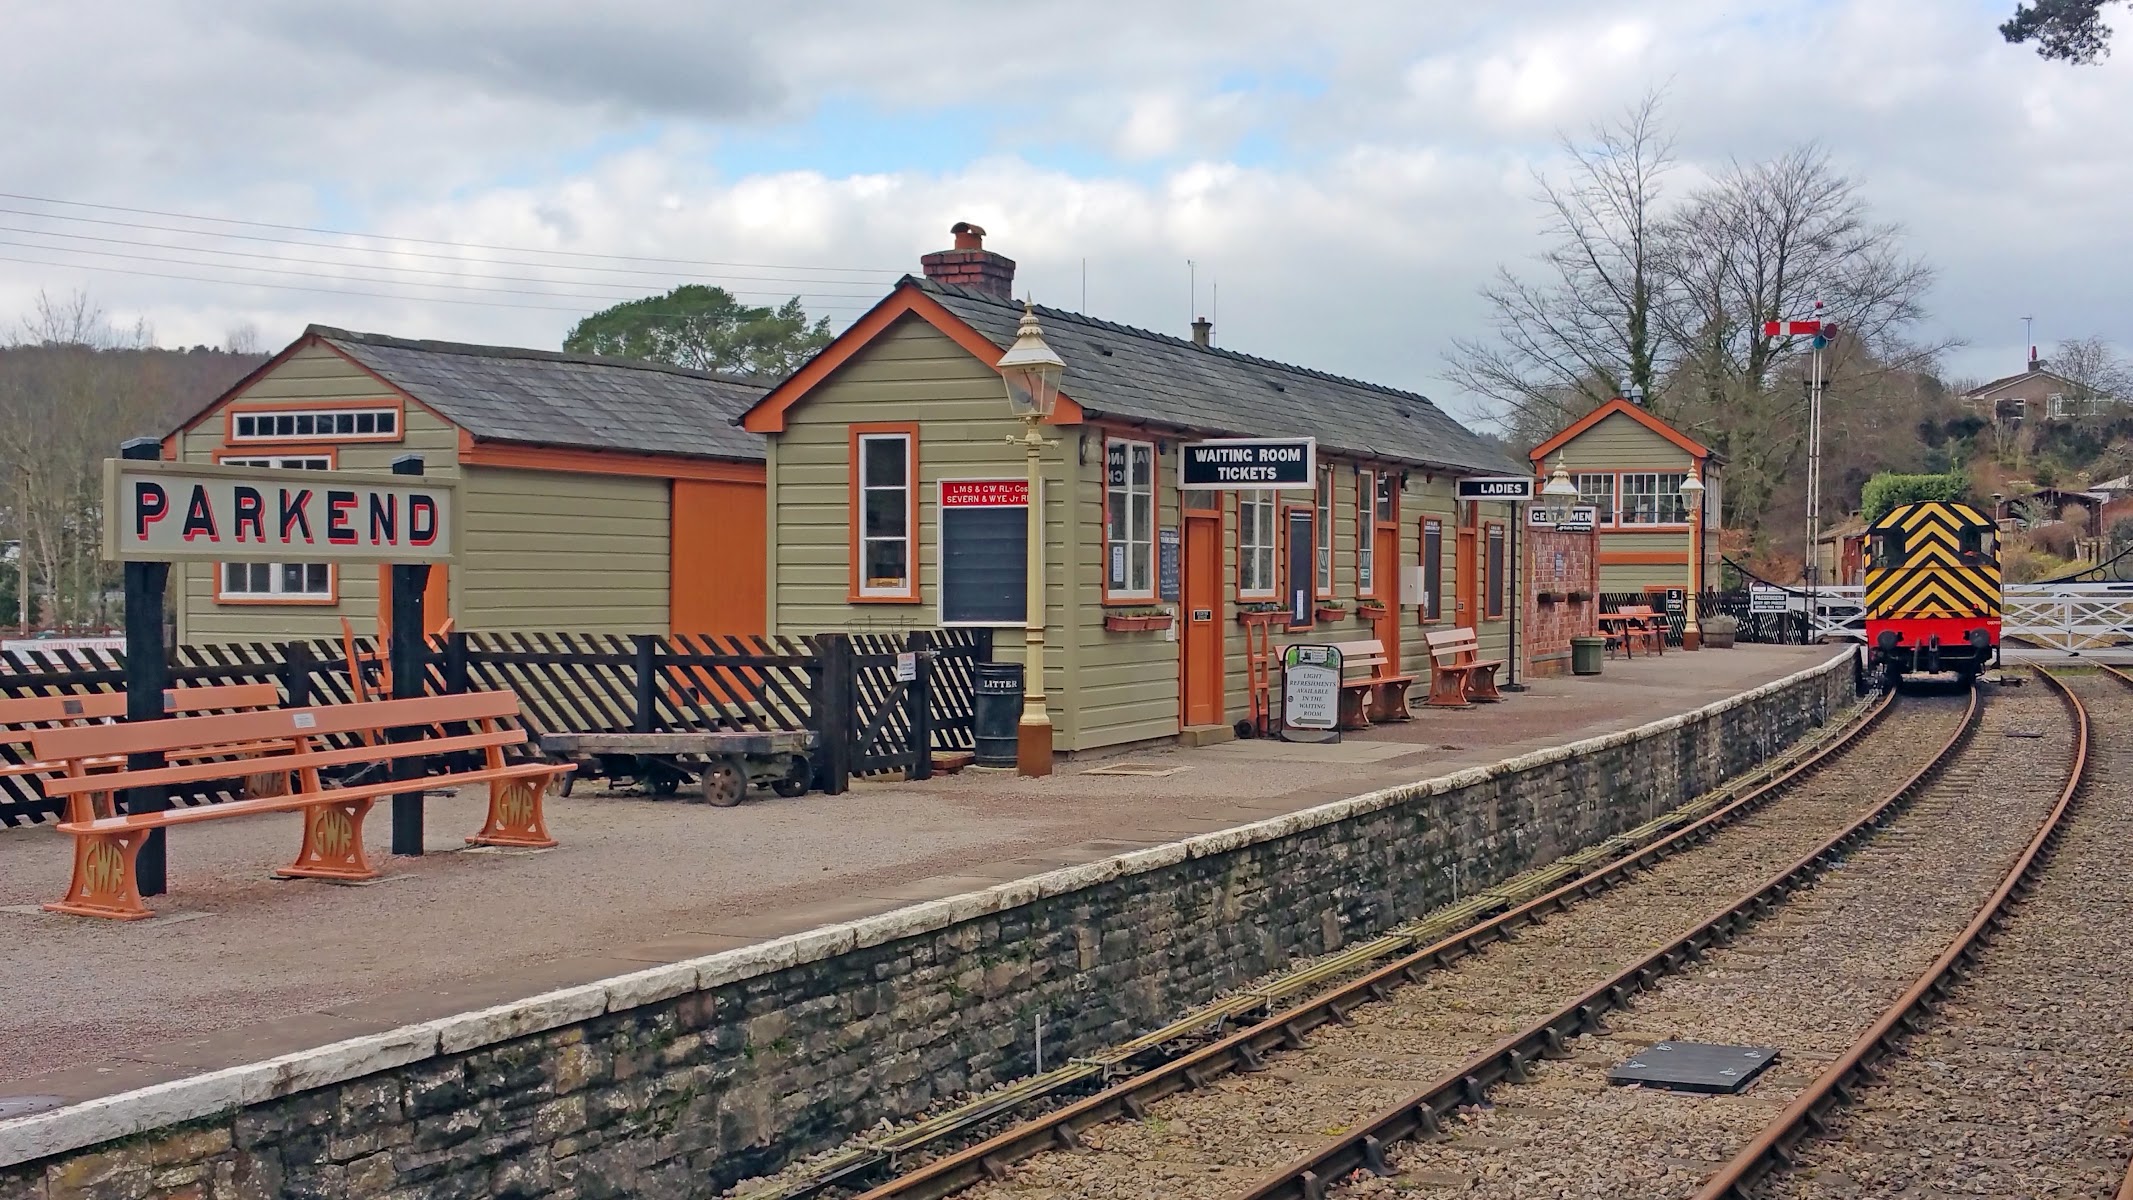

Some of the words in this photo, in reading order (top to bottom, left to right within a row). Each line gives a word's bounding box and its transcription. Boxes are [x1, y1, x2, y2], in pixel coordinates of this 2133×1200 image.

[1195, 449, 1253, 462] WAITING
[1259, 448, 1301, 462] ROOM
[1218, 467, 1277, 480] TICKETS
[974, 485, 981, 493] &
[982, 485, 997, 493] GW
[1480, 483, 1522, 494] LADIES
[946, 495, 979, 503] SEVERN
[981, 494, 988, 503] &
[989, 494, 1008, 503] WYE
[136, 482, 438, 546] PARKEND
[1671, 590, 1678, 599] 5
[984, 680, 1018, 688] LITTER
[496, 784, 534, 827] GWR
[312, 809, 353, 858] GWR
[83, 841, 125, 894] GWR
